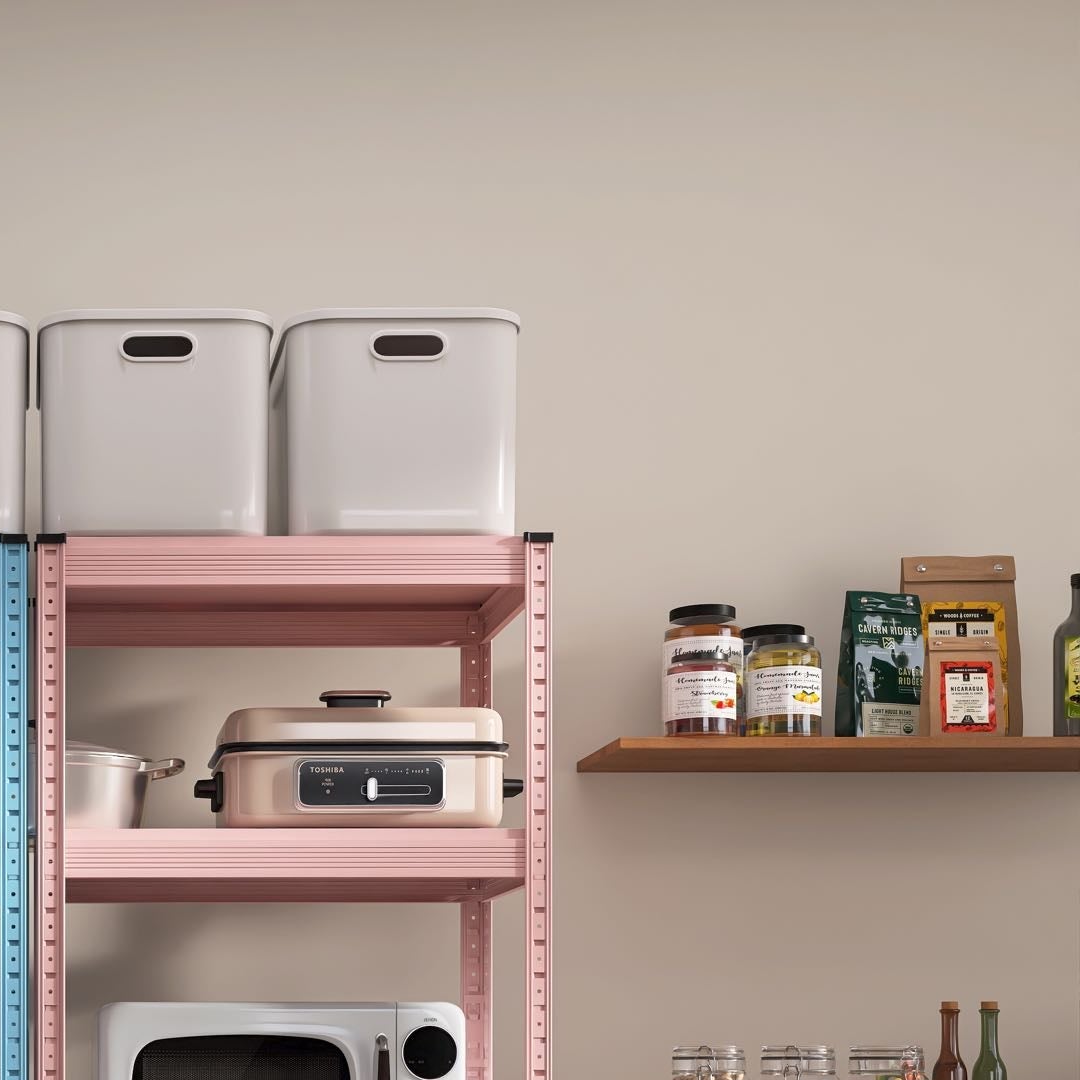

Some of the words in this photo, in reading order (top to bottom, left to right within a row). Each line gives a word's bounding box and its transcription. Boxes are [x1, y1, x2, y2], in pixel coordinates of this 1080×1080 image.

[857, 623, 888, 635] CAVERN
[889, 625, 918, 637] RIDGES
[898, 677, 924, 686] RIDGES
[309, 766, 345, 774] TOSHIBA
